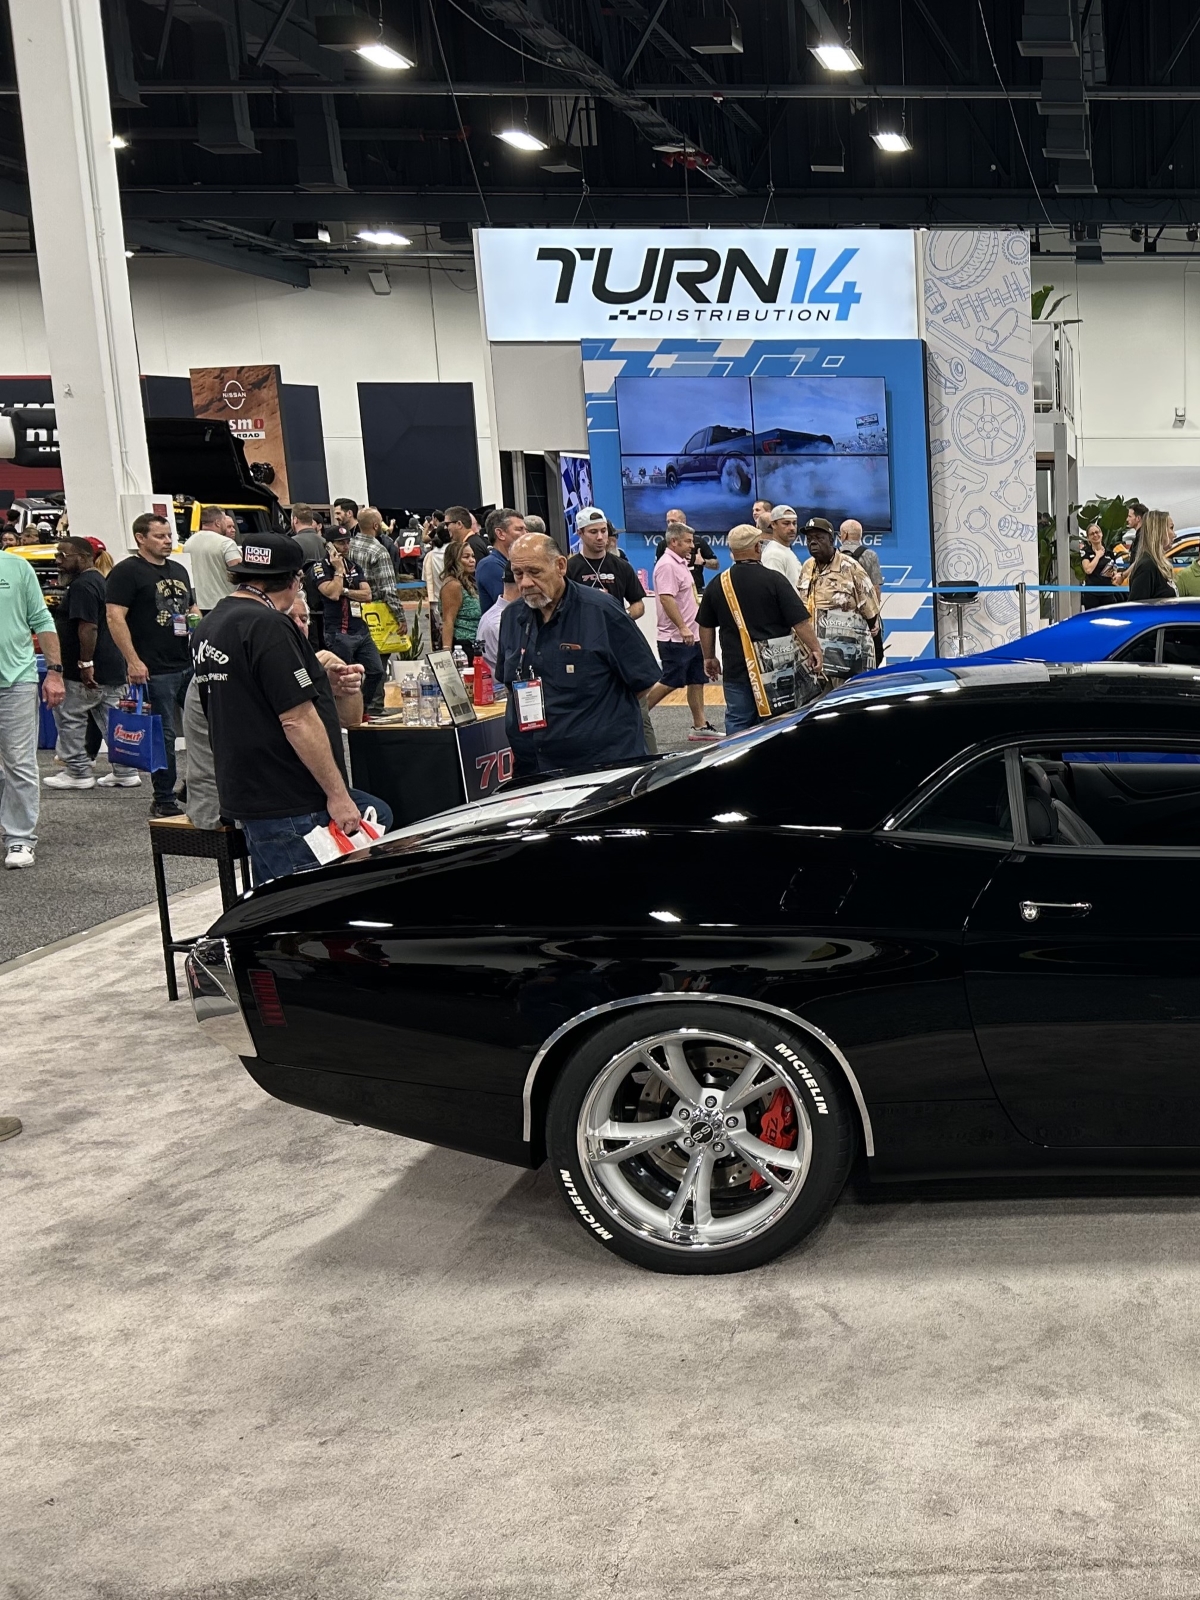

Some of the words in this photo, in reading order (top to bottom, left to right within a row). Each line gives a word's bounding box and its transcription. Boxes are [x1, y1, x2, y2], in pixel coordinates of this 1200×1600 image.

[536, 247, 861, 321] TURN14
[649, 309, 830, 321] DISTRIBUTION
[247, 546, 269, 556] LIQUI
[247, 554, 269, 563] MOLY
[774, 1042, 829, 1115] MICHELIN
[692, 1125, 711, 1141] SS
[560, 1168, 614, 1241] MICHELIN
